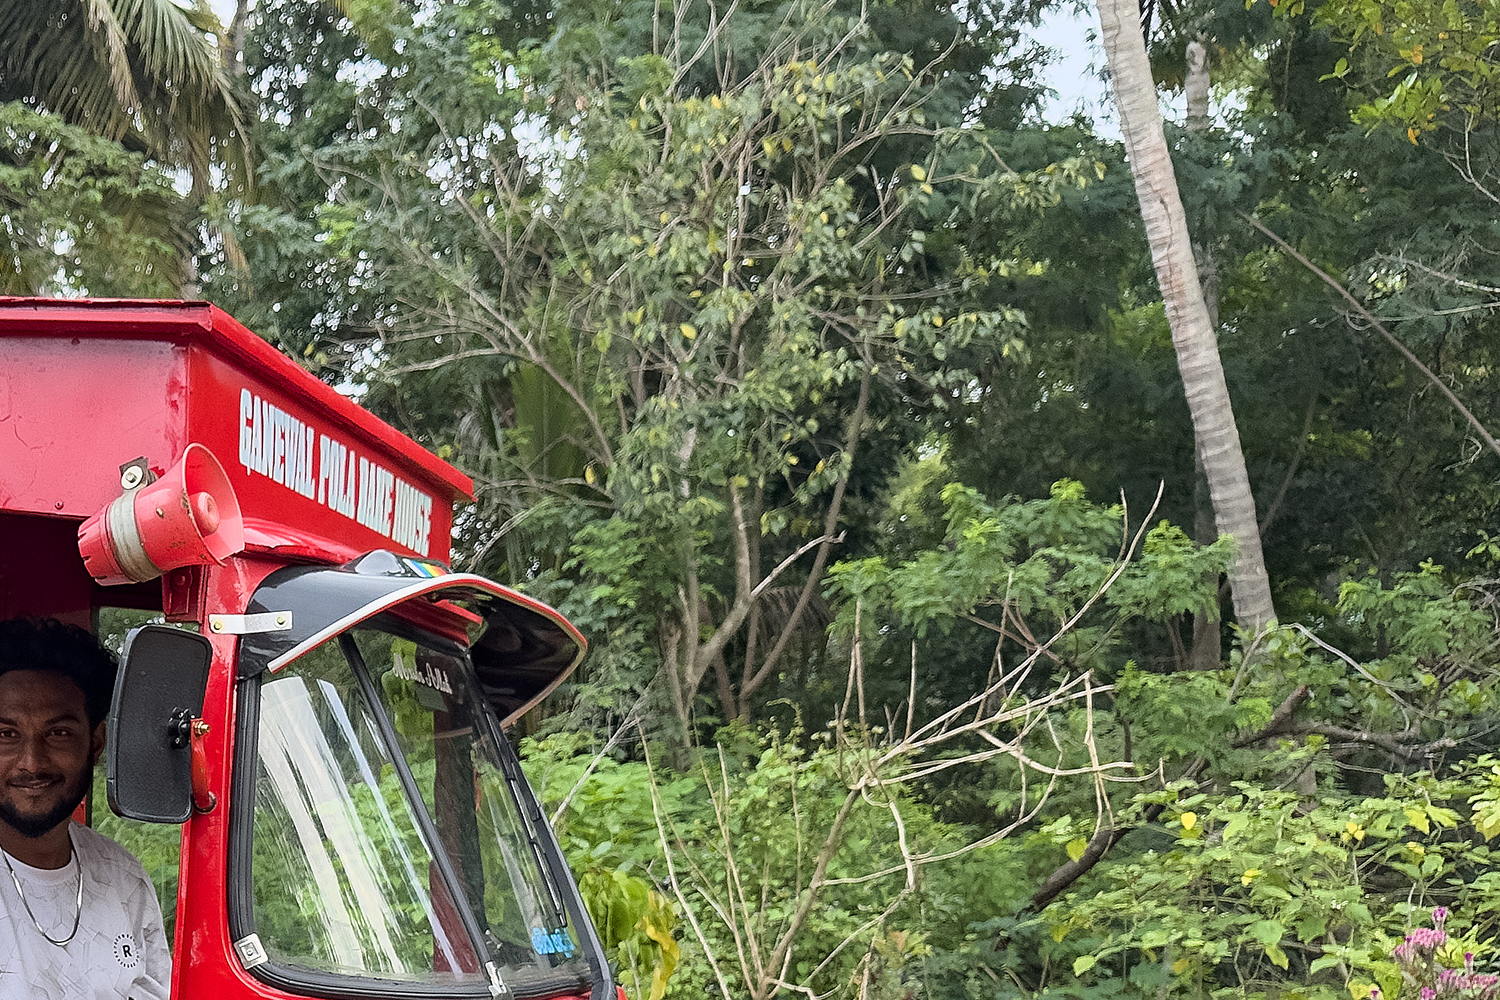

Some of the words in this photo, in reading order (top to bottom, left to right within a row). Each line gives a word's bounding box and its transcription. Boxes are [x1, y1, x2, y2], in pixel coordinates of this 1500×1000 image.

[317, 433, 357, 520] POLA
[356, 456, 395, 538] BAKE
[391, 476, 433, 558] HOUSE
[122, 944, 133, 958] R
